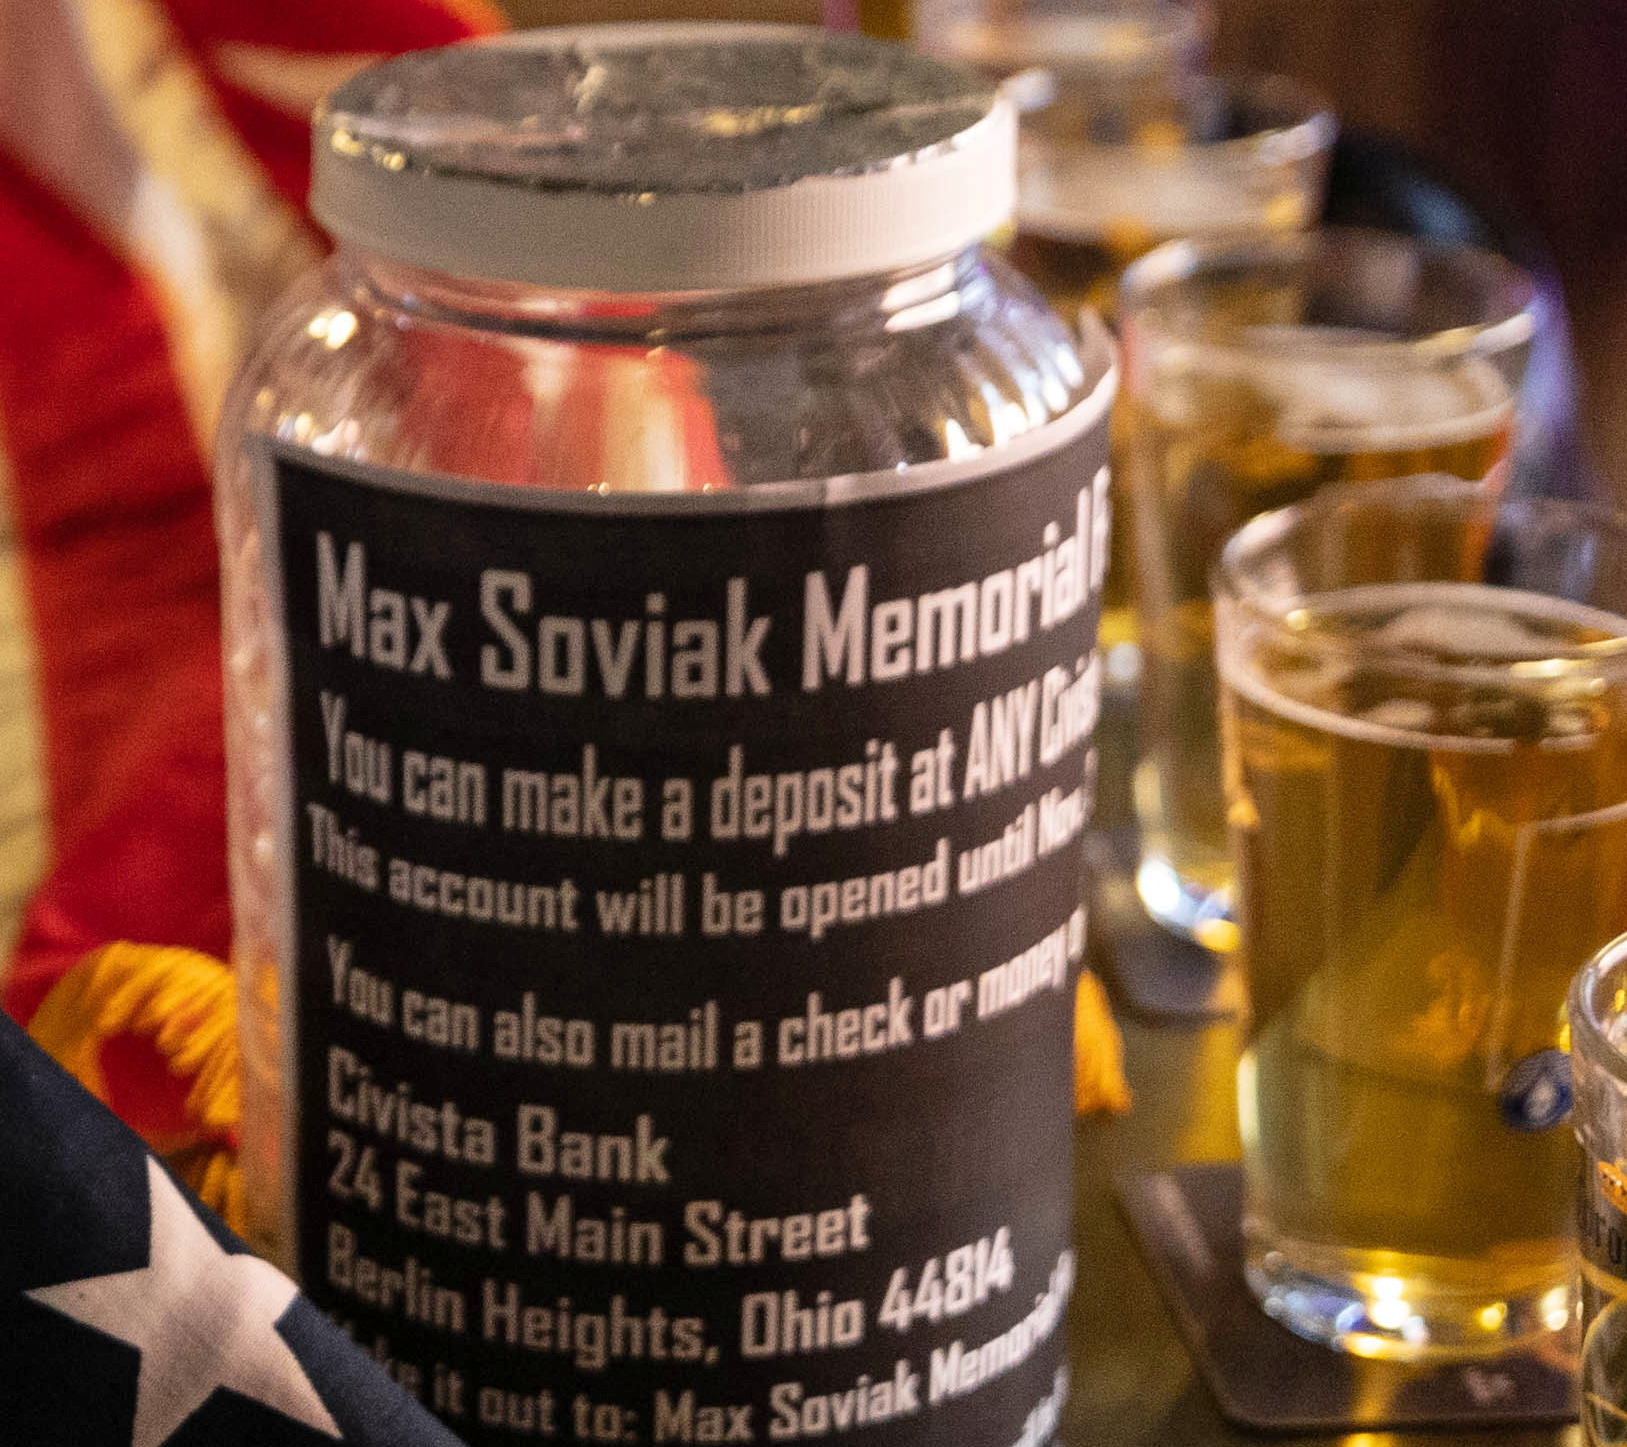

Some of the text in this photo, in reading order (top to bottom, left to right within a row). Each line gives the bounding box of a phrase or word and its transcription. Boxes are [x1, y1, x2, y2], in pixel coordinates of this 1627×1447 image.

[316, 529, 453, 681] Max
[478, 566, 774, 701] Soviak
[800, 484, 1091, 693] Memorial
[320, 690, 392, 807] You
[402, 749, 488, 829] can
[501, 743, 643, 842] make
[660, 775, 693, 842] a
[710, 737, 899, 856] deposit
[909, 727, 960, 815] at
[962, 677, 1041, 801] ANY
[306, 799, 381, 893] This
[387, 856, 579, 932] account
[595, 871, 687, 937] will
[701, 871, 766, 938] be
[778, 837, 951, 942] opened
[957, 802, 1037, 898] until
[327, 931, 395, 1029] You
[401, 988, 481, 1052] can
[492, 989, 597, 1069] also
[609, 998, 719, 1073] mail
[731, 1018, 764, 1072] a
[776, 974, 915, 1069] check
[922, 978, 974, 1042] or
[977, 920, 1071, 1021] money
[327, 1044, 673, 1186] Civista Bank
[327, 1128, 874, 1267] 24 East Main Street
[327, 1220, 469, 1335] Berlin
[481, 1277, 721, 1370] Heights,
[741, 1288, 867, 1360] Ohio
[876, 1224, 1017, 1334] 44814
[433, 1361, 466, 1416] it
[477, 1384, 555, 1436] out
[572, 1392, 640, 1443] to:
[654, 1387, 757, 1445] Max
[768, 1357, 922, 1440] Soviak
